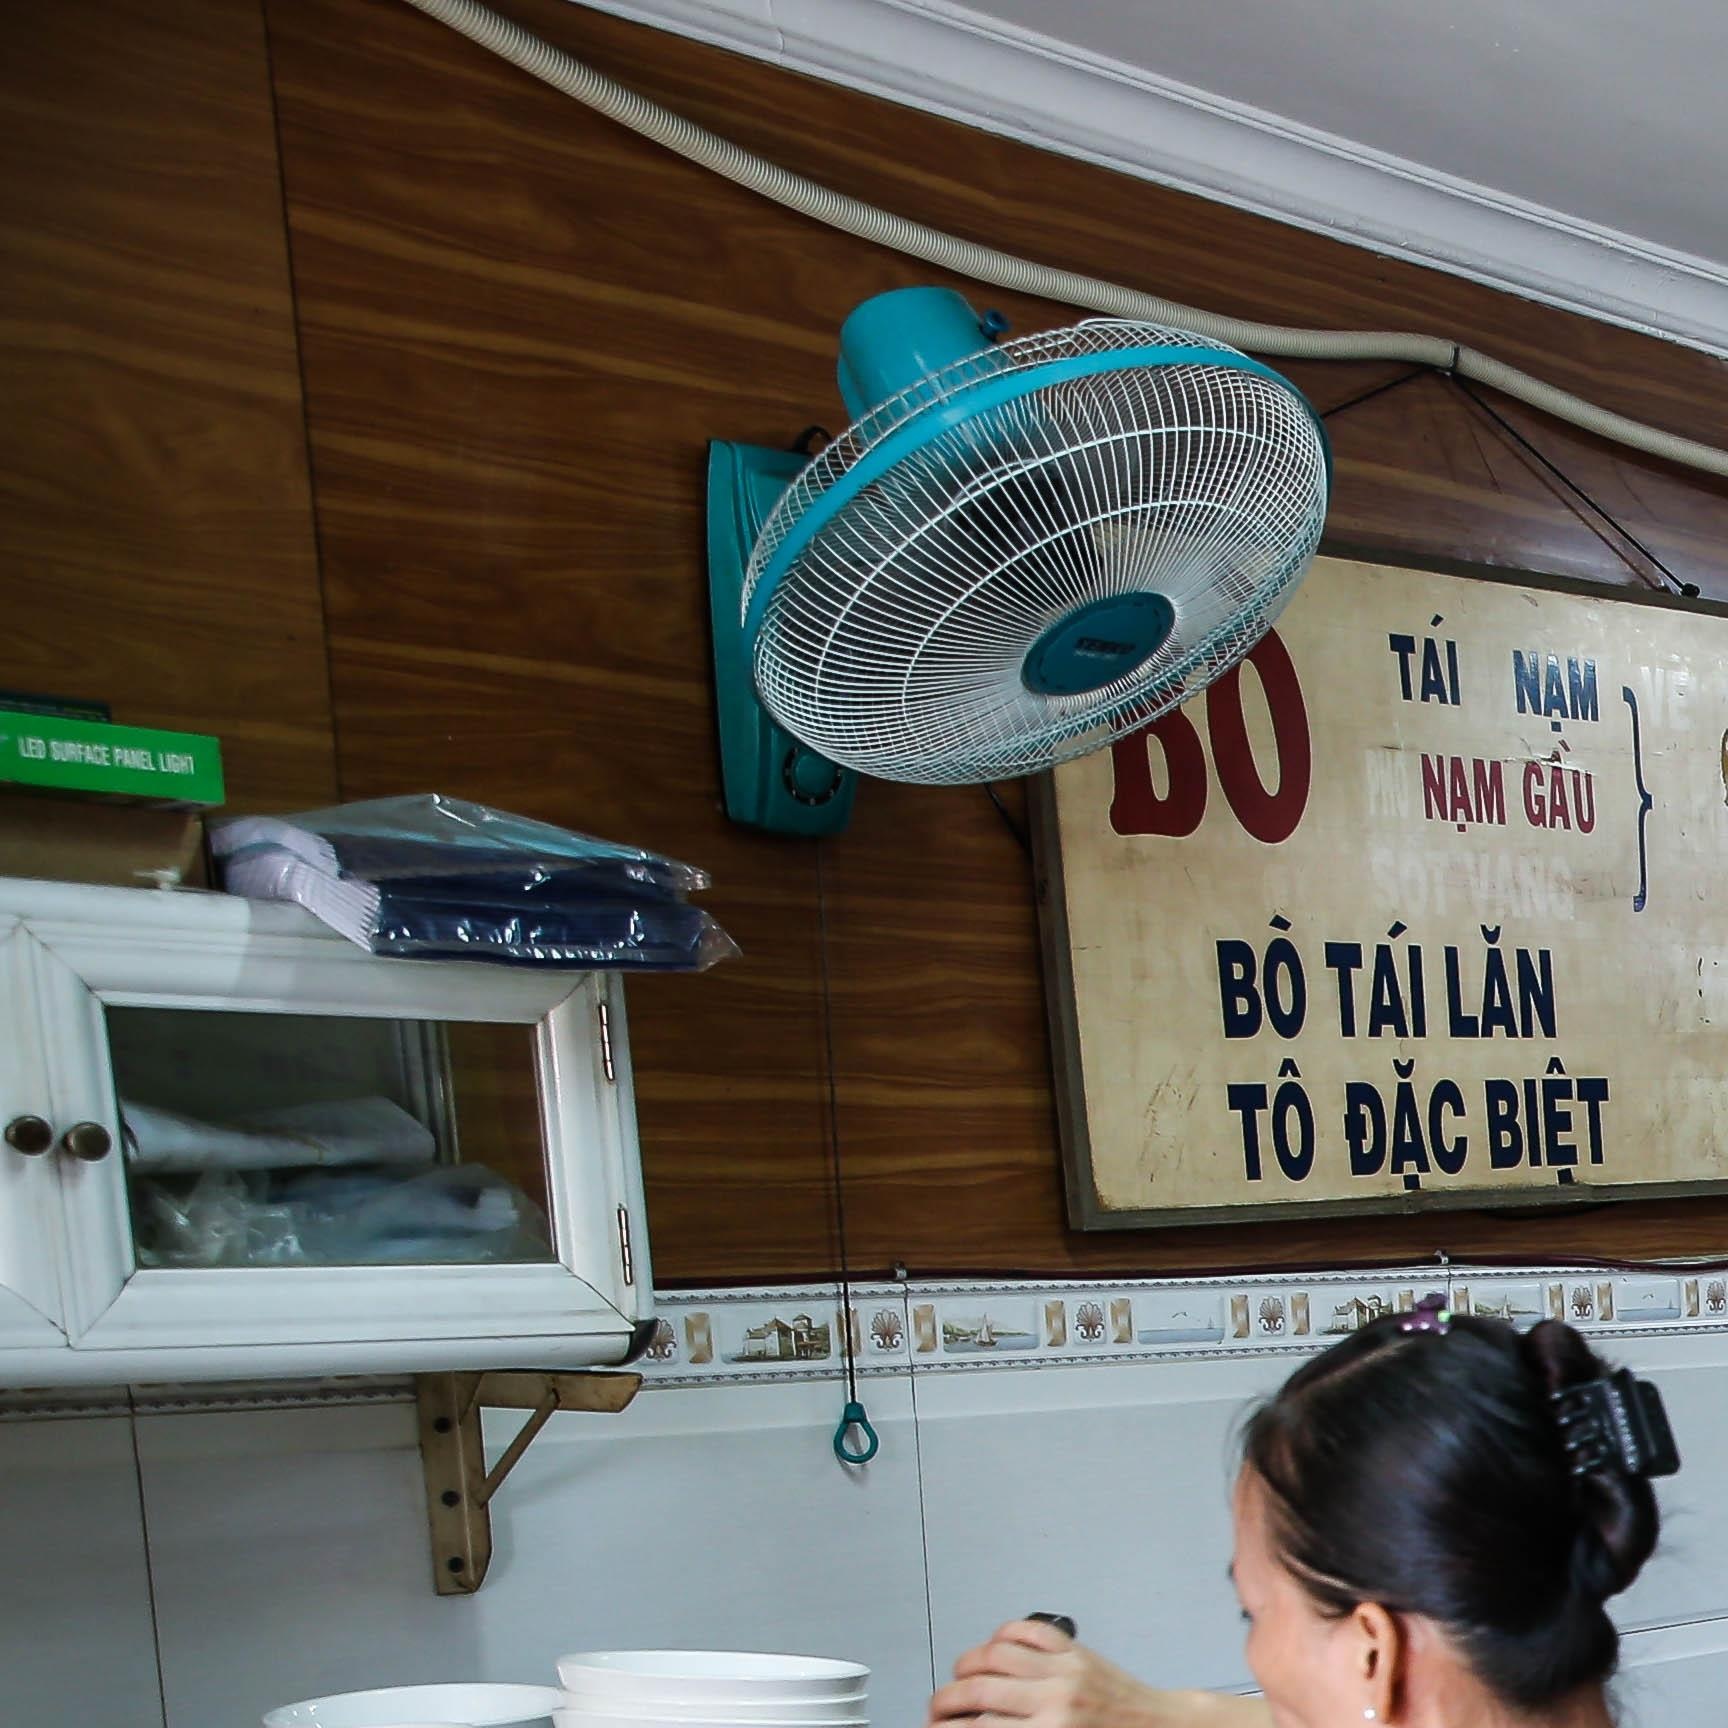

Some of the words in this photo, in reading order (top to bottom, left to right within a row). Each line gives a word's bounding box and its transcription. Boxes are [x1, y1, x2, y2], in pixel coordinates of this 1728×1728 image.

[1389, 613, 1461, 707] TÁI
[1513, 650, 1600, 732] NẠM
[17, 735, 47, 760] LED
[48, 740, 112, 767] SURFACE
[112, 746, 157, 771] PANEL
[158, 752, 195, 775] LIGHT
[1420, 752, 1507, 833] NẠM
[1522, 739, 1597, 834] GẦU
[1215, 913, 1307, 1039] BÒ
[1324, 920, 1427, 1039] TÁI
[1444, 924, 1557, 1039] LĂN
[1226, 1058, 1316, 1182] TÔ
[1343, 1059, 1468, 1191] ĐẶC
[1486, 1057, 1610, 1185] BIỆT
